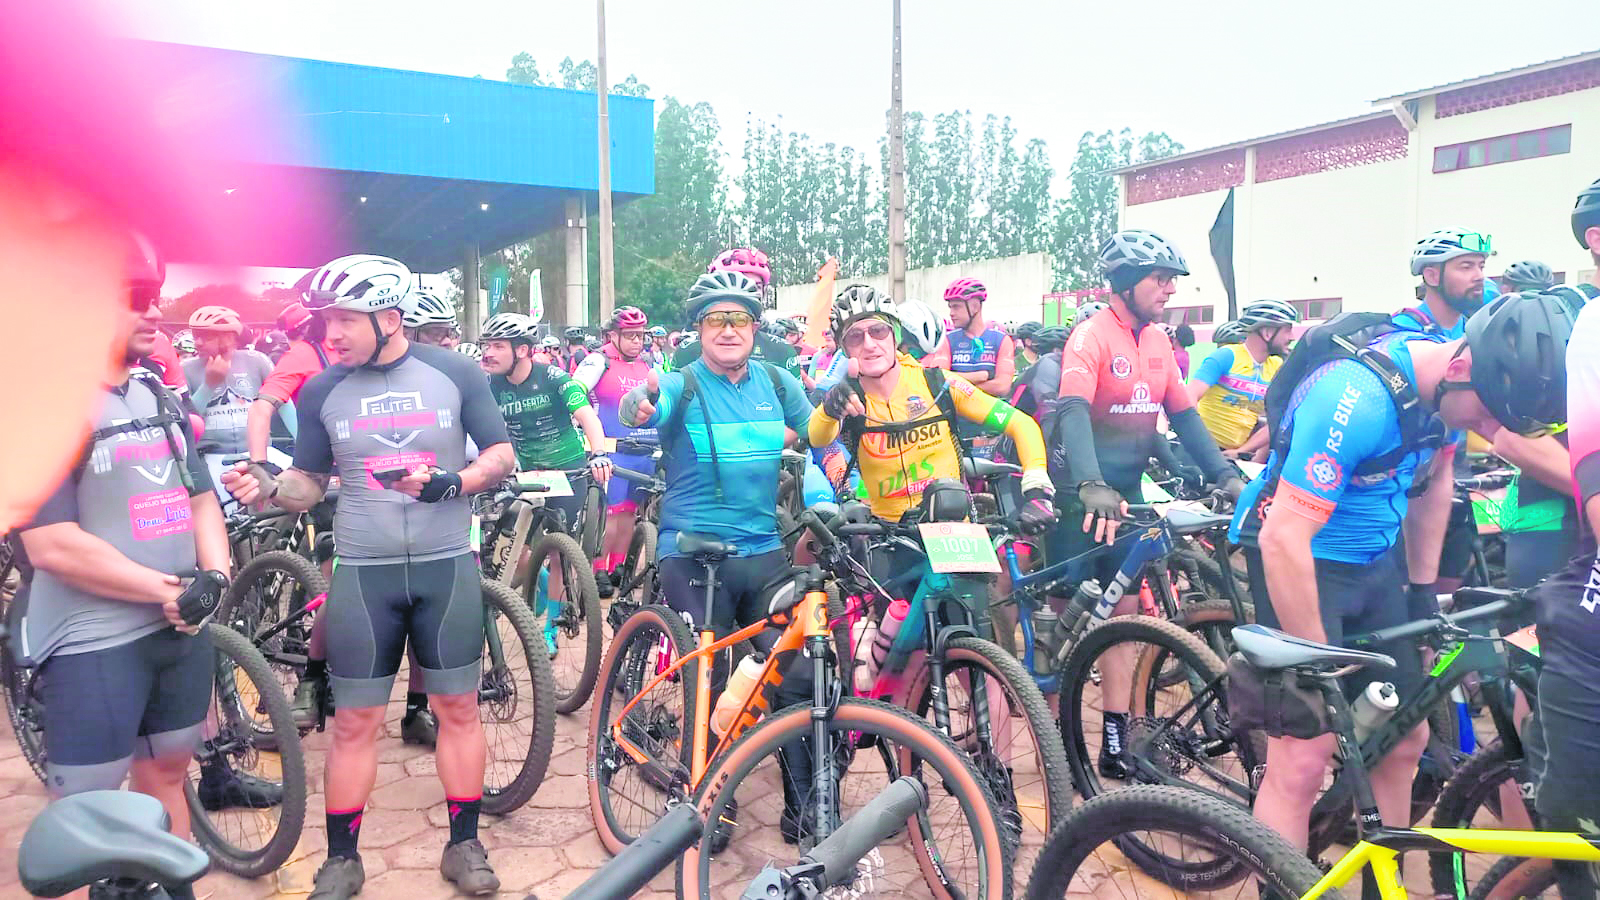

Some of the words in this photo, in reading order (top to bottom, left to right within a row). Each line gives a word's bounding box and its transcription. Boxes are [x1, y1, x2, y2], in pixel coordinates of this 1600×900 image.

[369, 295, 400, 307] GIRO
[952, 354, 971, 363] PRO
[953, 381, 975, 397] BIKE
[370, 399, 413, 415] ELITE
[1333, 384, 1362, 427] BIKE
[1326, 426, 1344, 454] RS
[879, 452, 936, 497] DIAS
[939, 537, 978, 553] 1007
[1105, 721, 1121, 754] CALOI
